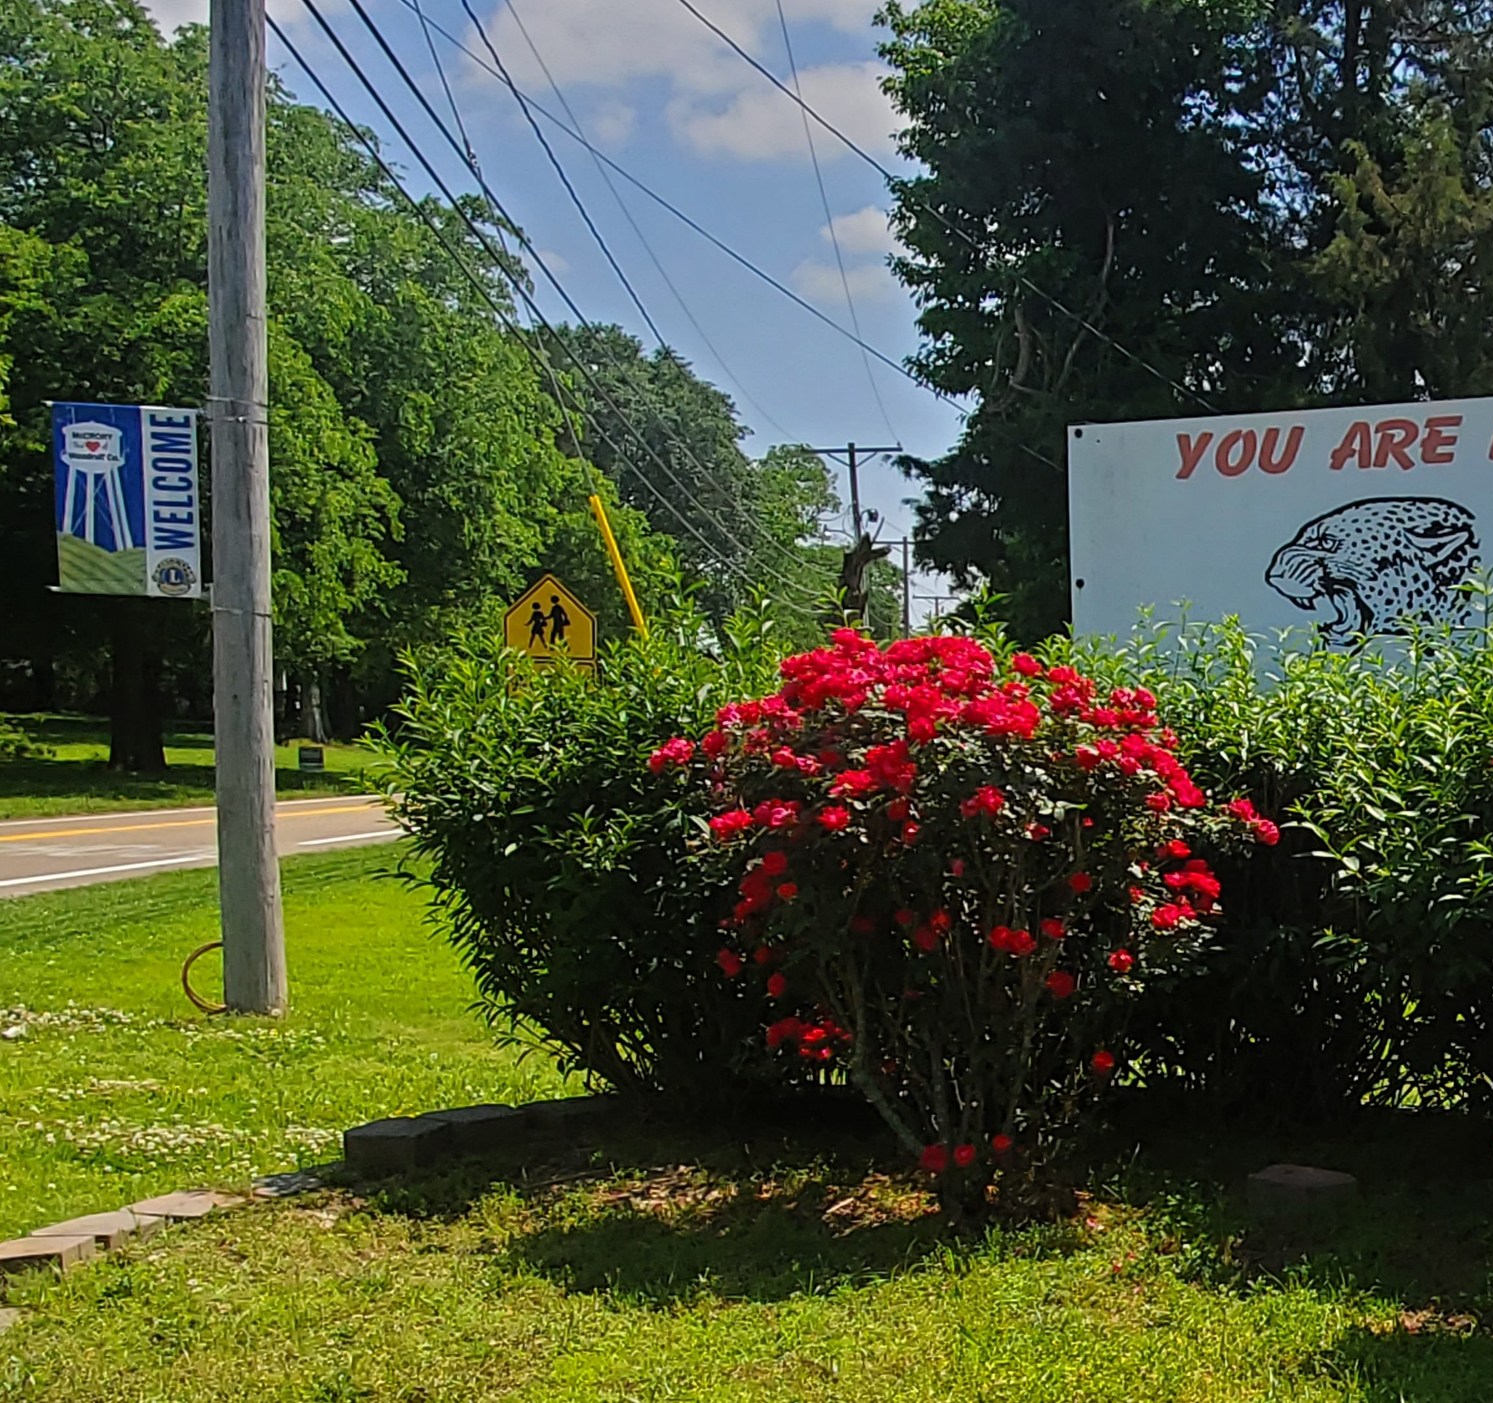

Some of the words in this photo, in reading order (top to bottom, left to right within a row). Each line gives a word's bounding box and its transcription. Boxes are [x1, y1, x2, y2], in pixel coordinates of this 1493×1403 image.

[149, 413, 195, 551] WELCOME
[1174, 425, 1305, 480] YOU
[1329, 415, 1464, 471] ARE
